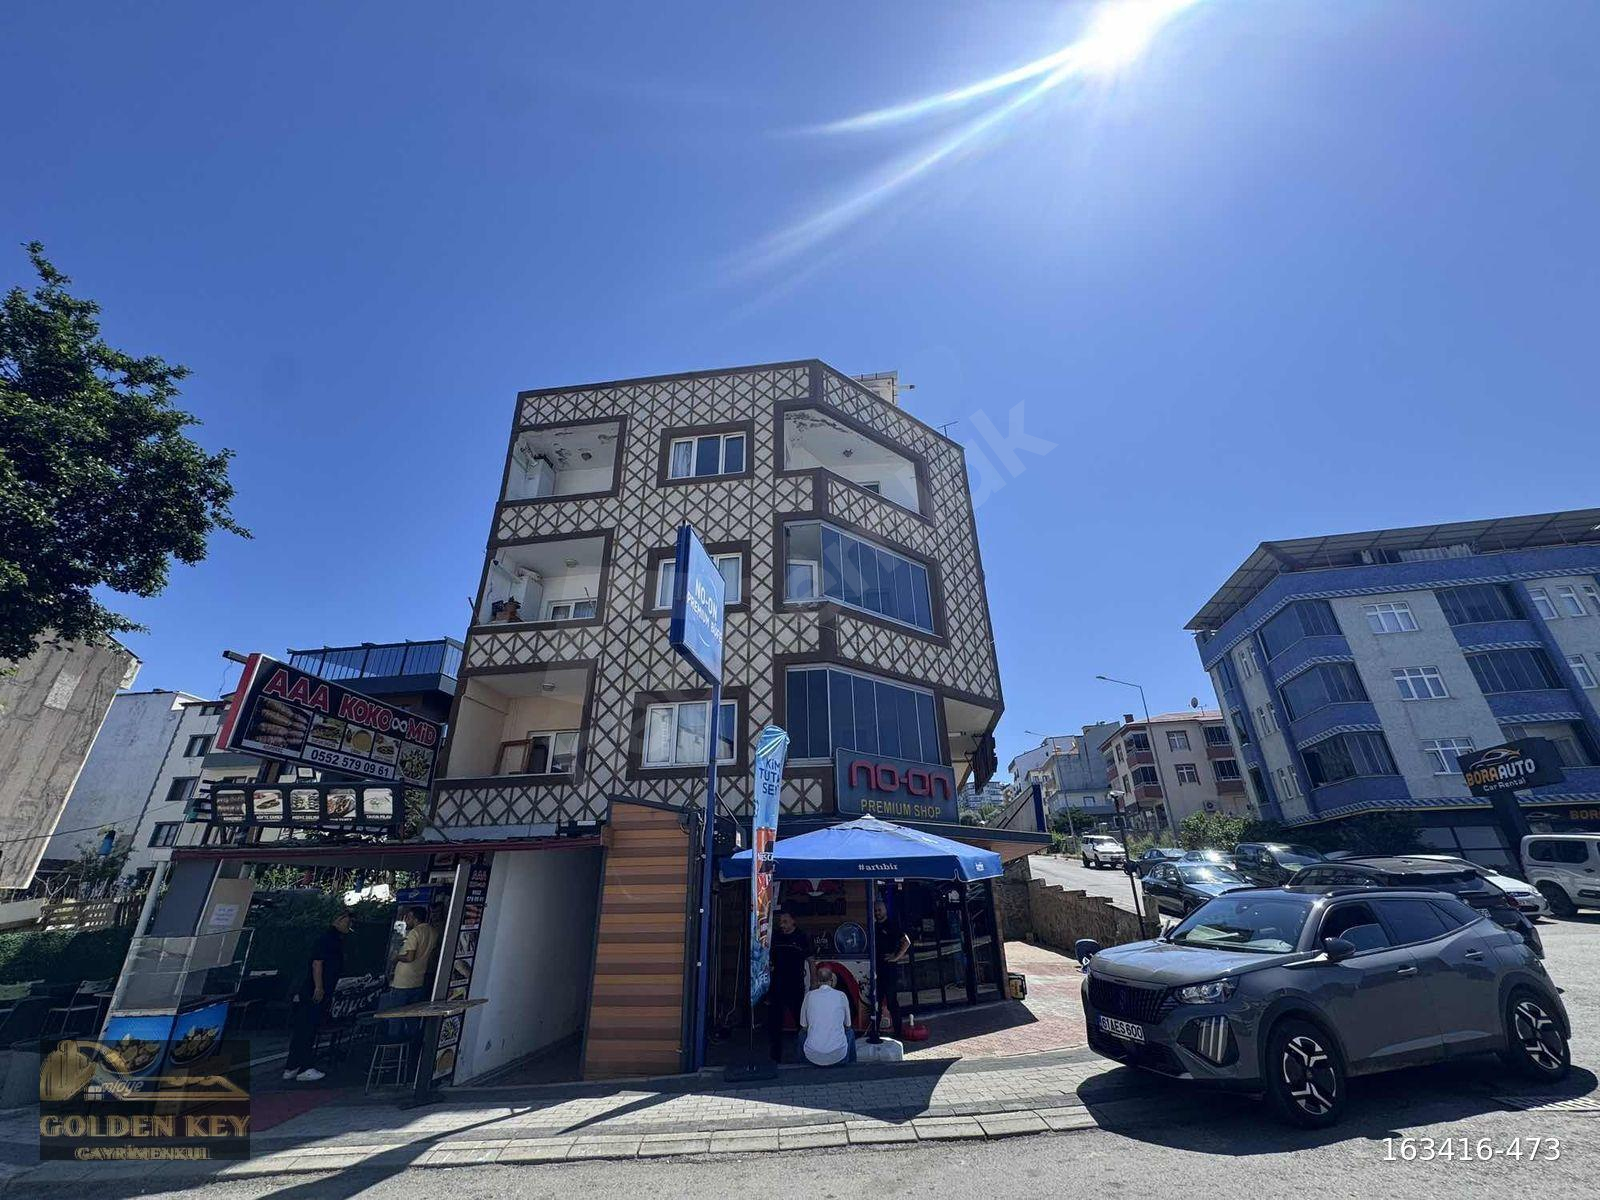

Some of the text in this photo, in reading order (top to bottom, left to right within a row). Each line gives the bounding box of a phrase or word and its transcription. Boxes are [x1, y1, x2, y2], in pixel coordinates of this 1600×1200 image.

[695, 579, 718, 621] NO-ON
[262, 668, 329, 713] AAA
[338, 694, 393, 731] KOKO
[311, 749, 339, 765] 0552
[342, 757, 361, 770] 579
[364, 762, 375, 774] 09
[378, 766, 389, 776] 61
[1483, 778, 1526, 792] Car Rental
[861, 799, 942, 818] PREMIUM SHOP
[1570, 810, 1600, 820] BOR
